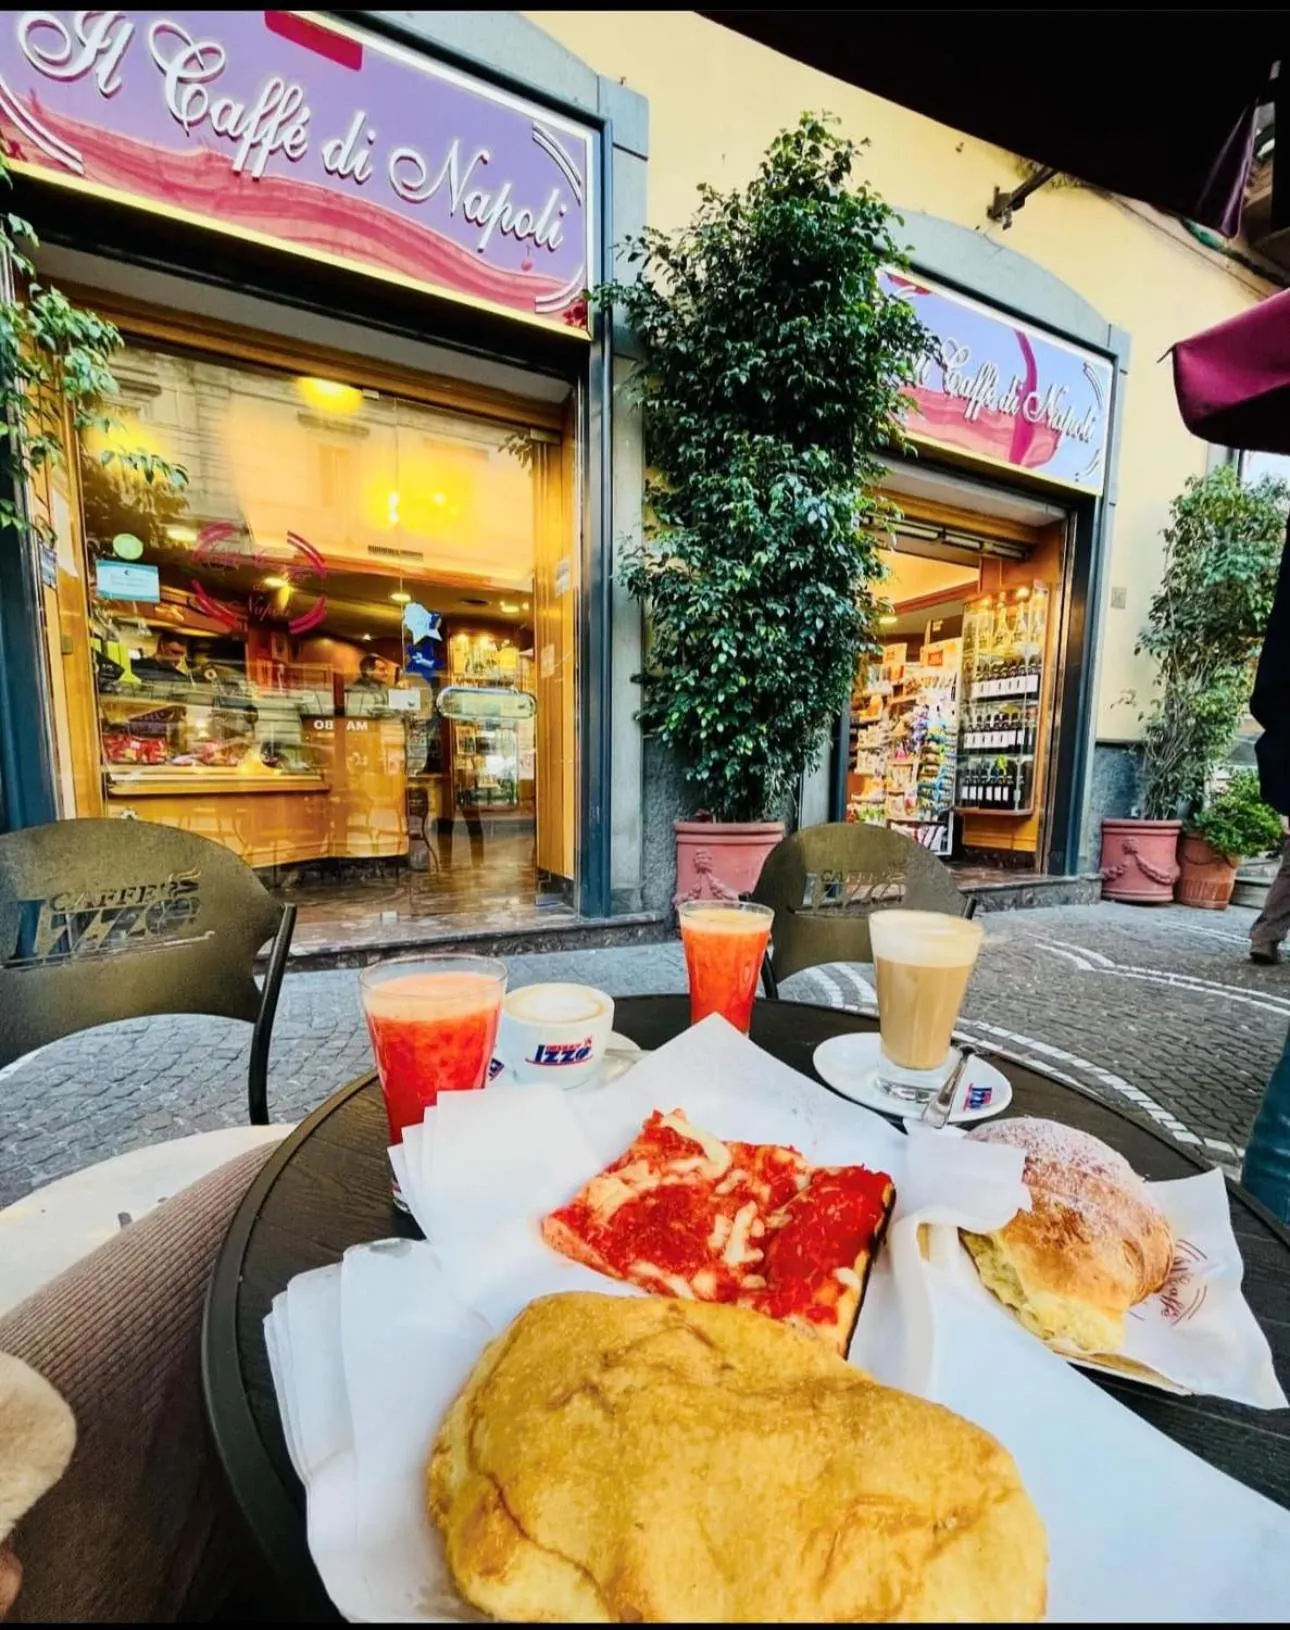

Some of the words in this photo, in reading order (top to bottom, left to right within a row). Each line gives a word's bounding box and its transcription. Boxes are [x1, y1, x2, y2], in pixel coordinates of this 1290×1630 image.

[322, 111, 376, 186] di
[390, 138, 568, 253] Napoli
[999, 375, 1021, 416] di
[1023, 384, 1097, 446] Napoli
